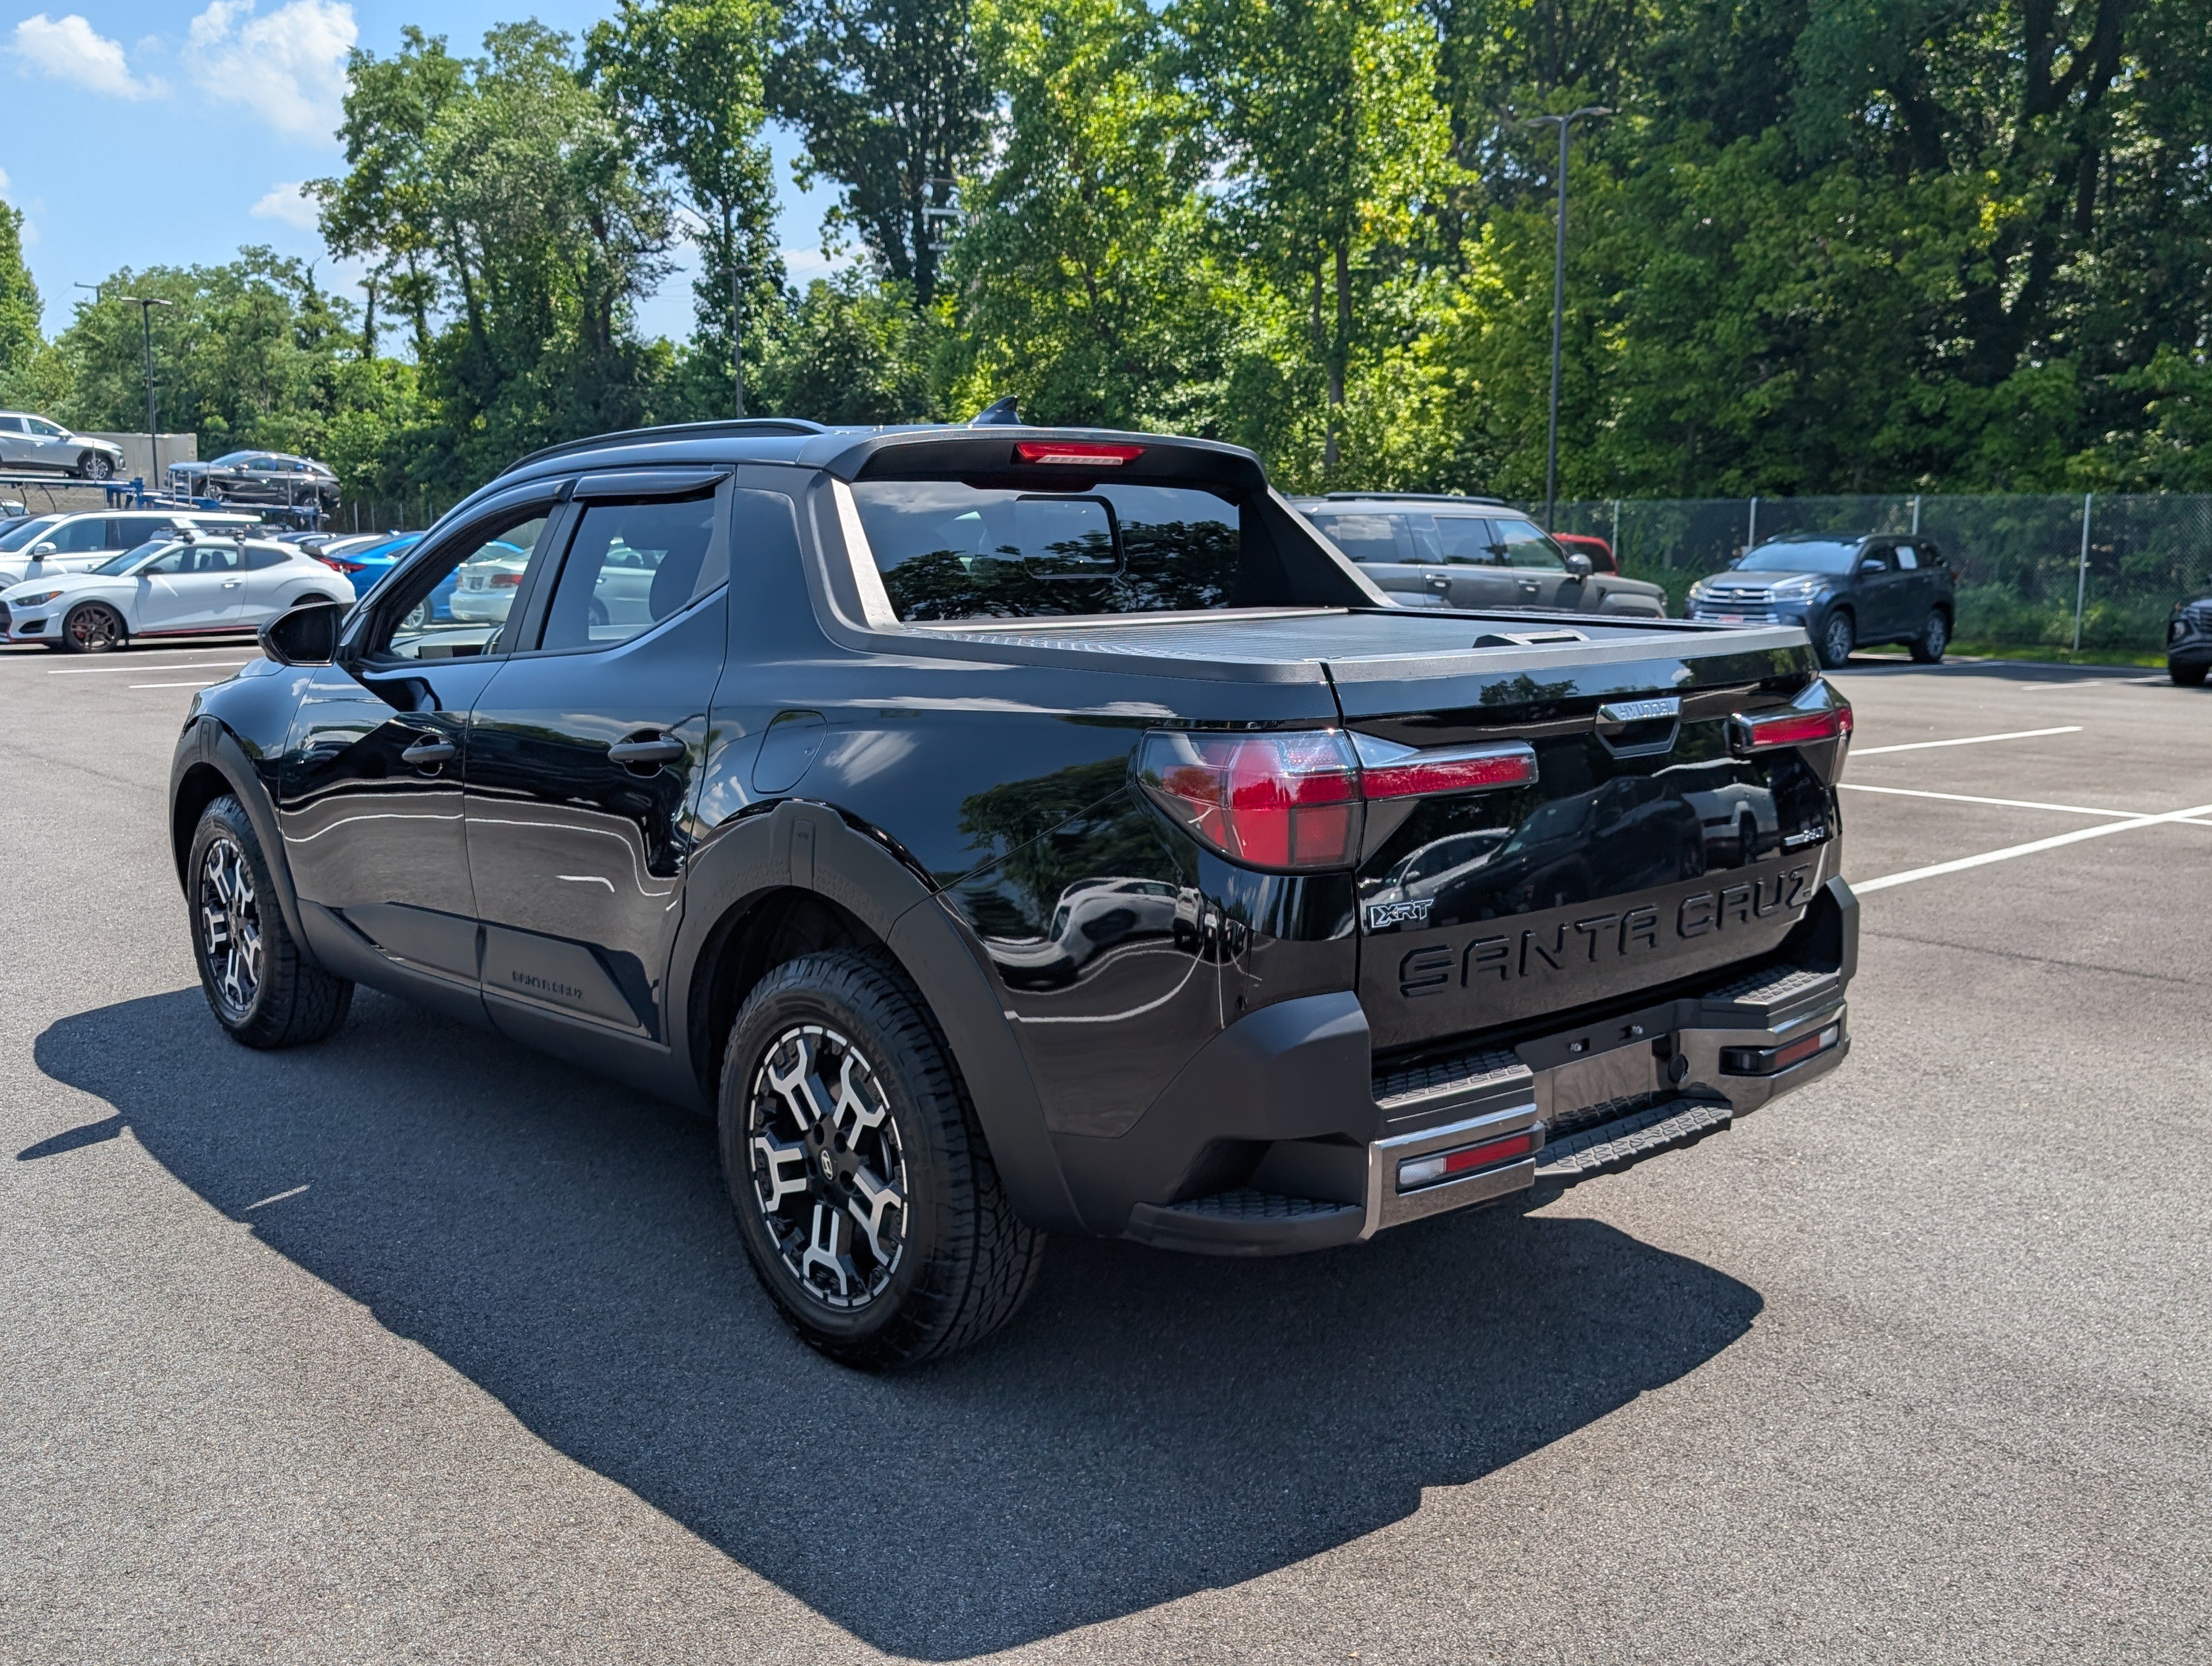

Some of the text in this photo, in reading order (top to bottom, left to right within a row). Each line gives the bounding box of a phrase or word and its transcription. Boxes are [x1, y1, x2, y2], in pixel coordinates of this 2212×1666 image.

[1618, 700, 1674, 719] HYUNDAI
[1371, 898, 1435, 928] XRT
[1398, 864, 1812, 998] SANTA CRUZ
